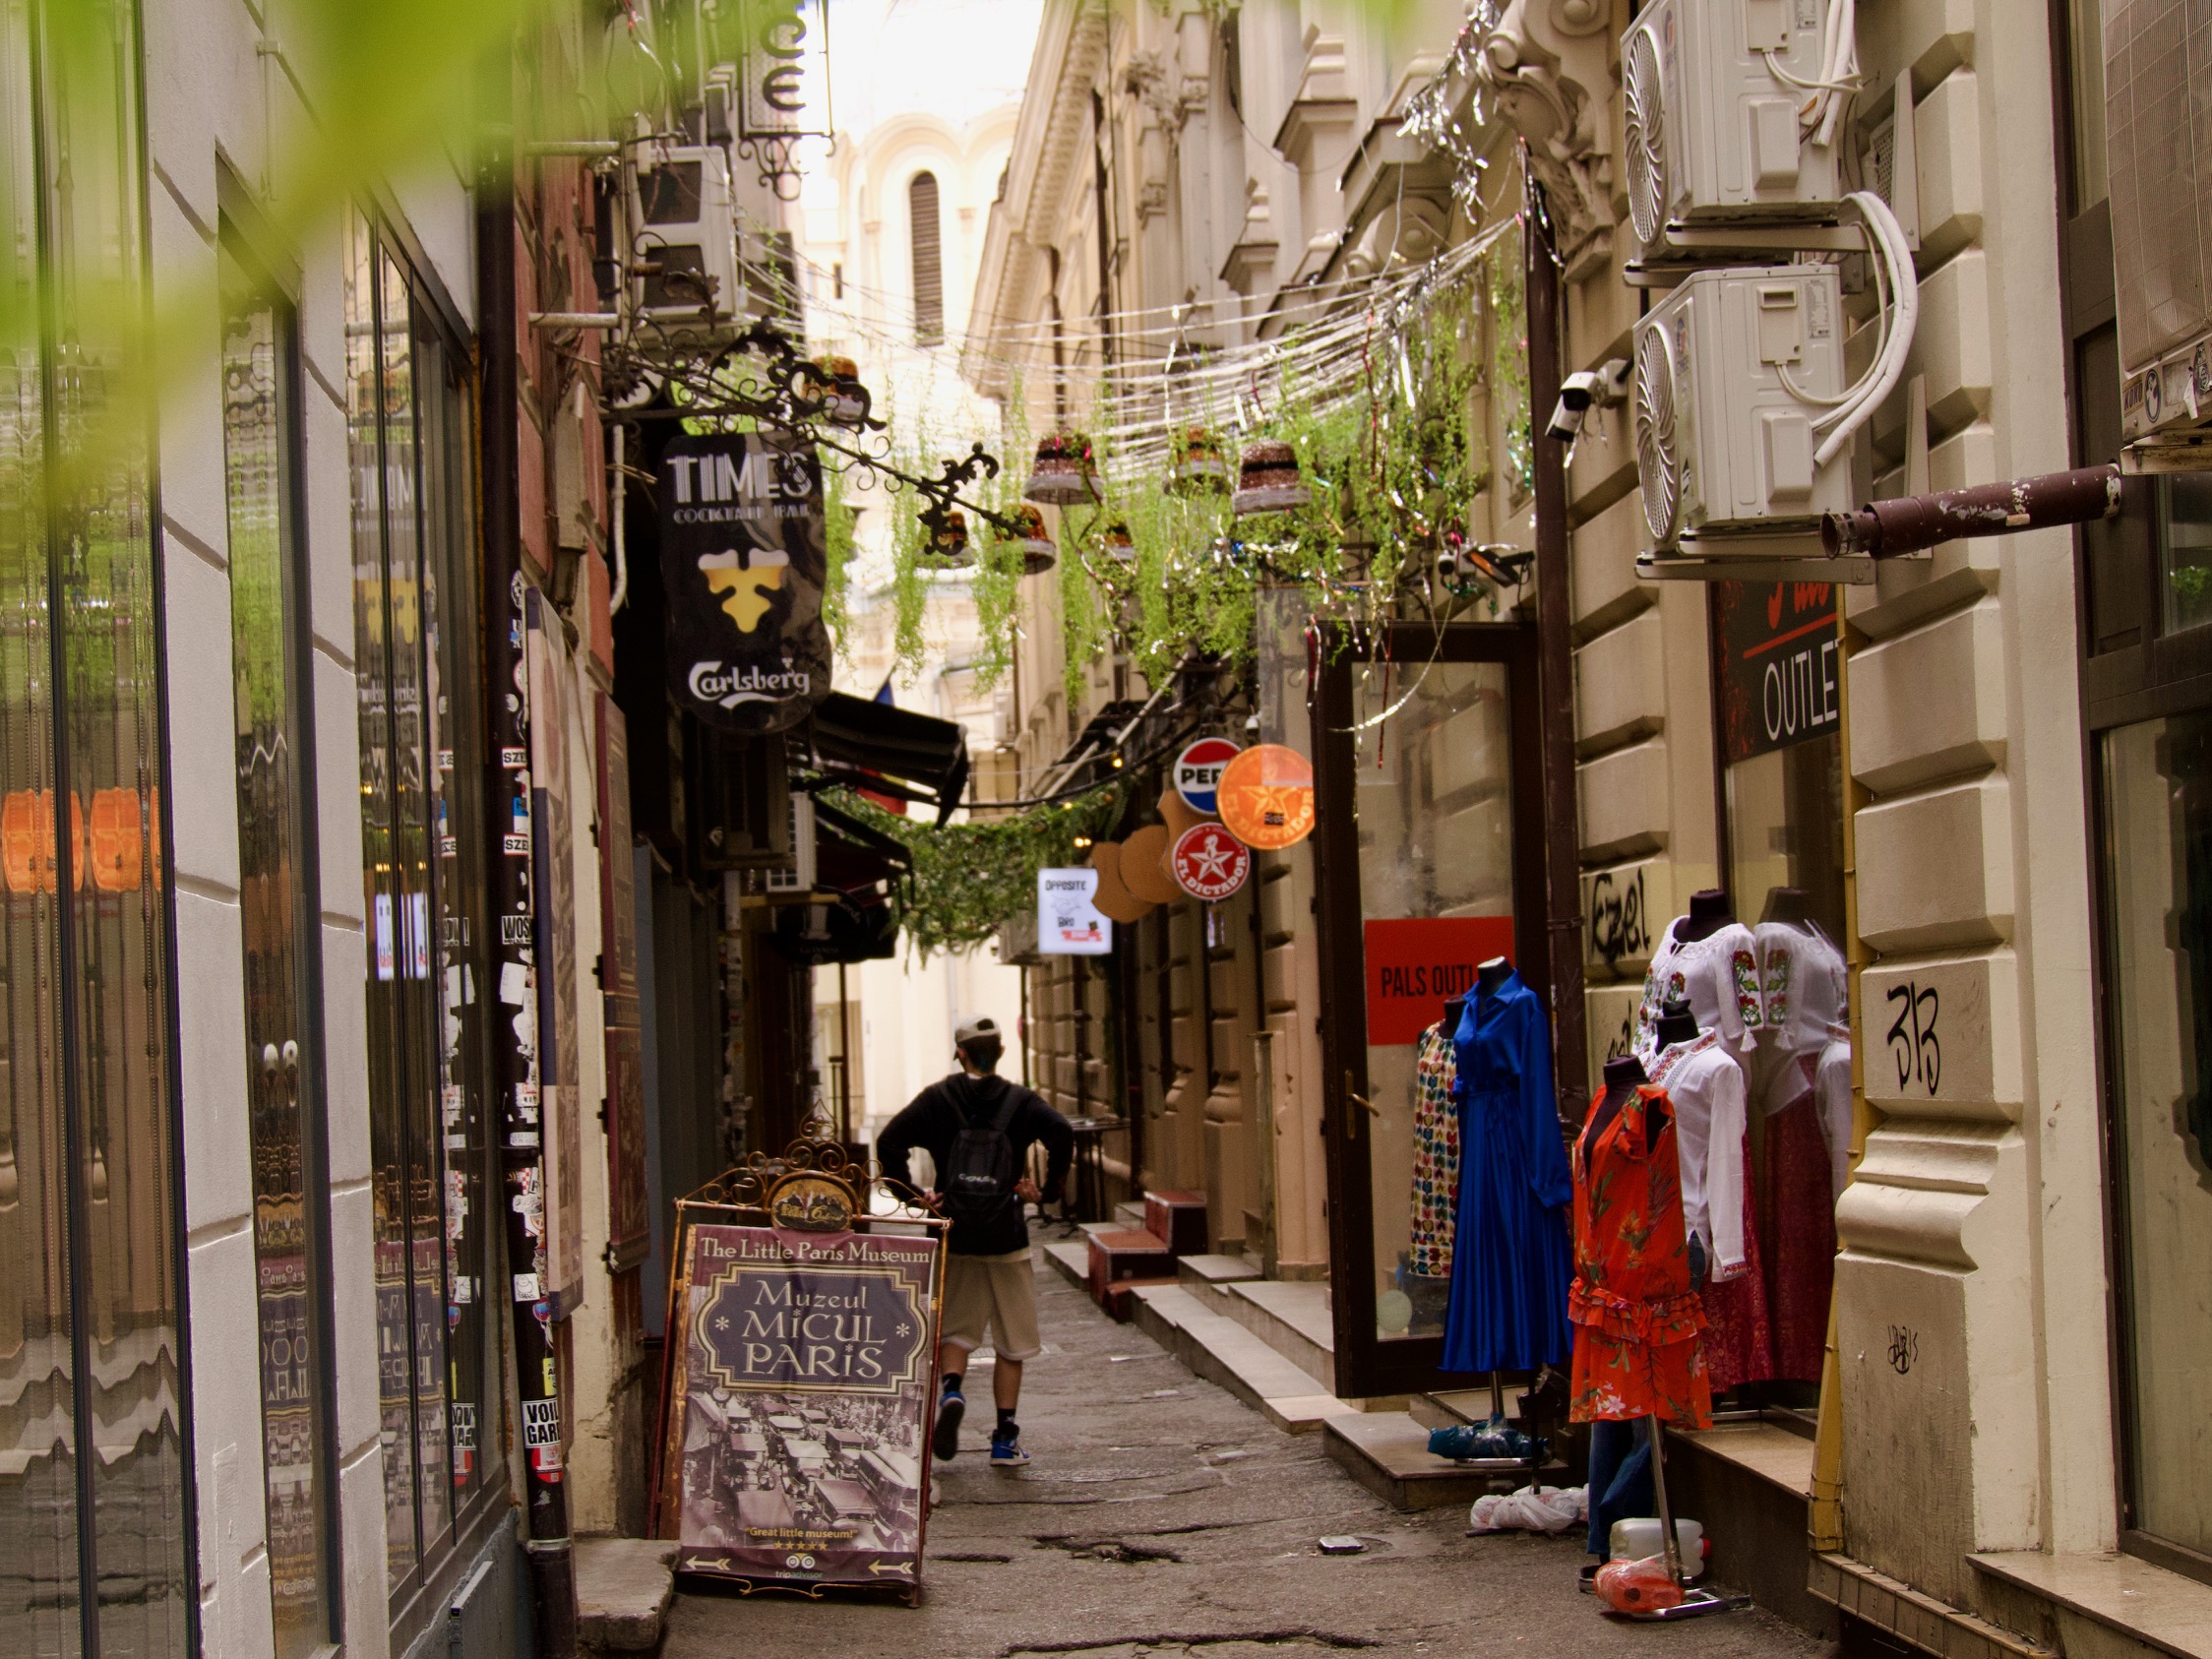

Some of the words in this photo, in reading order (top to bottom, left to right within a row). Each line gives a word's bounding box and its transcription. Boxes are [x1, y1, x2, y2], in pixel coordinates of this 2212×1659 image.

[666, 452, 813, 503] TIMES
[689, 659, 810, 703] Carlsberg
[1764, 639, 1840, 741] OUTLE
[1177, 858, 1191, 879] EL
[1186, 856, 1247, 895] DICTADOR
[1381, 965, 1427, 999] PALS
[701, 1237, 737, 1259] The
[740, 1238, 793, 1260] Little
[798, 1242, 844, 1261] Paris
[847, 1242, 931, 1263] Museum
[754, 1279, 867, 1310] Muzeul
[779, 1527, 805, 1538] little
[775, 1570, 824, 1579] tripadvisor
